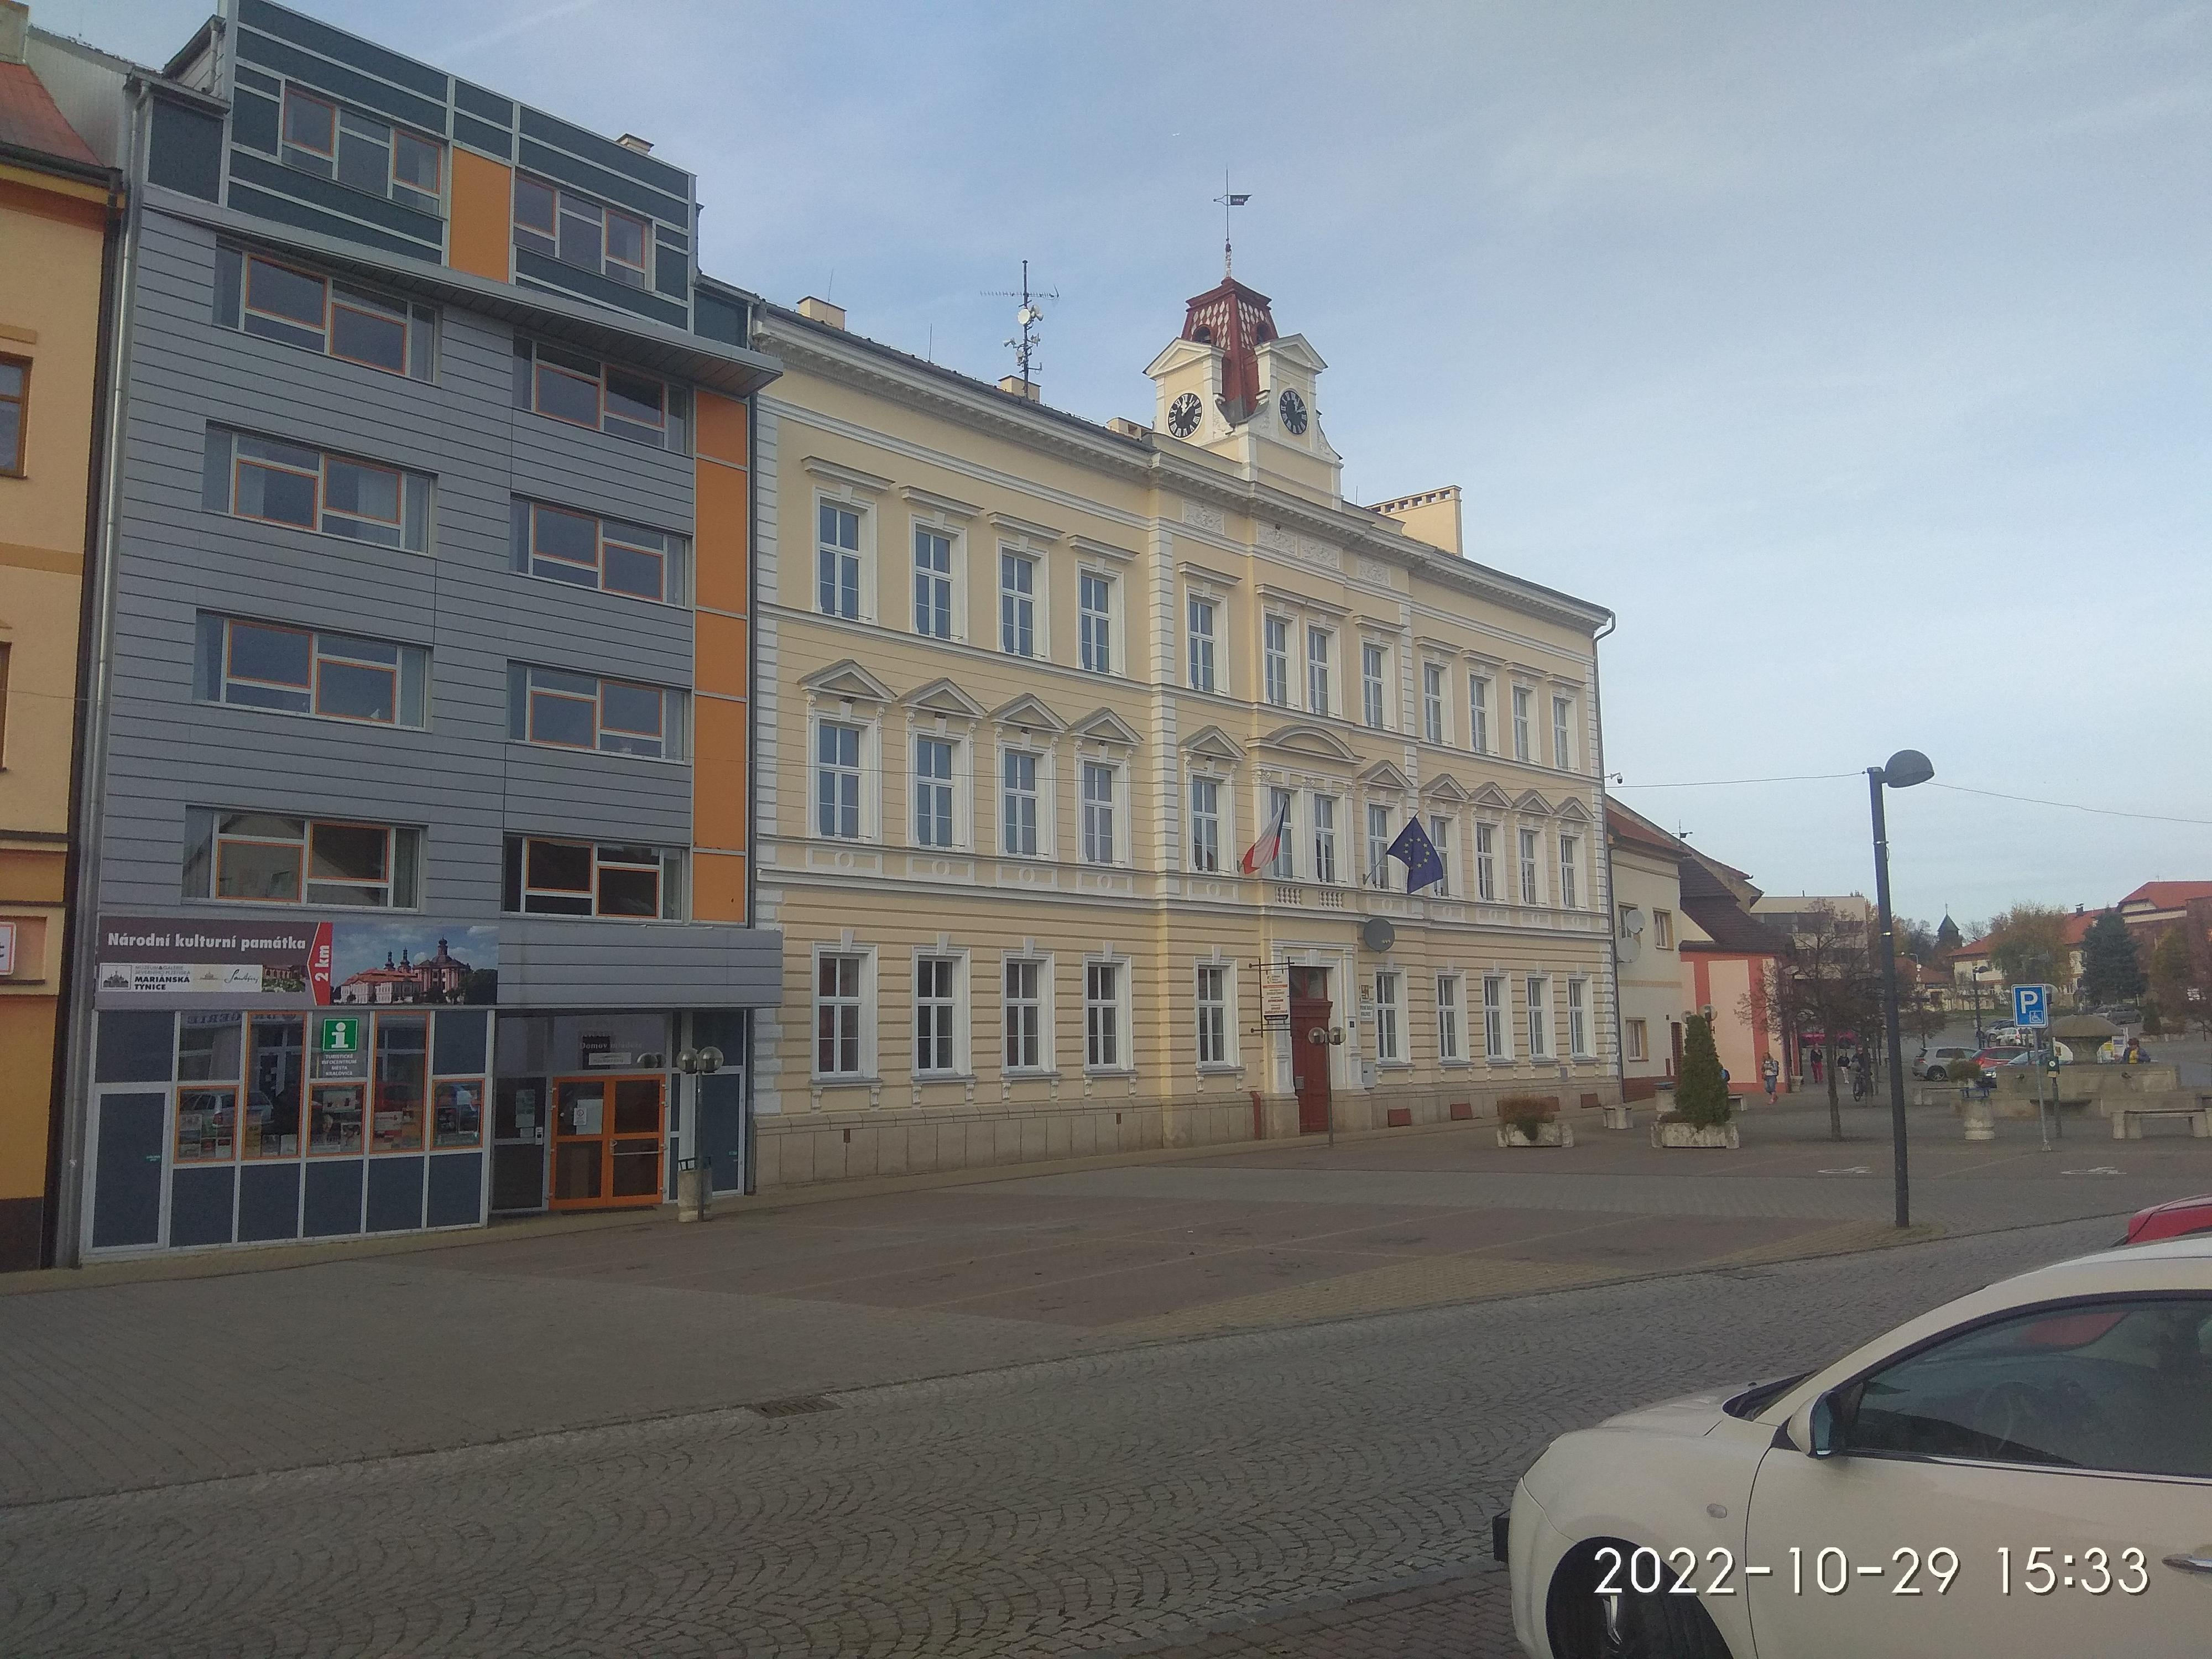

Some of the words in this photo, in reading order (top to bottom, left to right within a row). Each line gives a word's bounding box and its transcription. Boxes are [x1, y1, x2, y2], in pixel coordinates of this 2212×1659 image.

[108, 932, 170, 947] Národní
[175, 933, 236, 948] kulturní
[241, 936, 306, 951] památka
[315, 945, 330, 968] km
[315, 973, 328, 982] 2
[2020, 990, 2038, 1014] P
